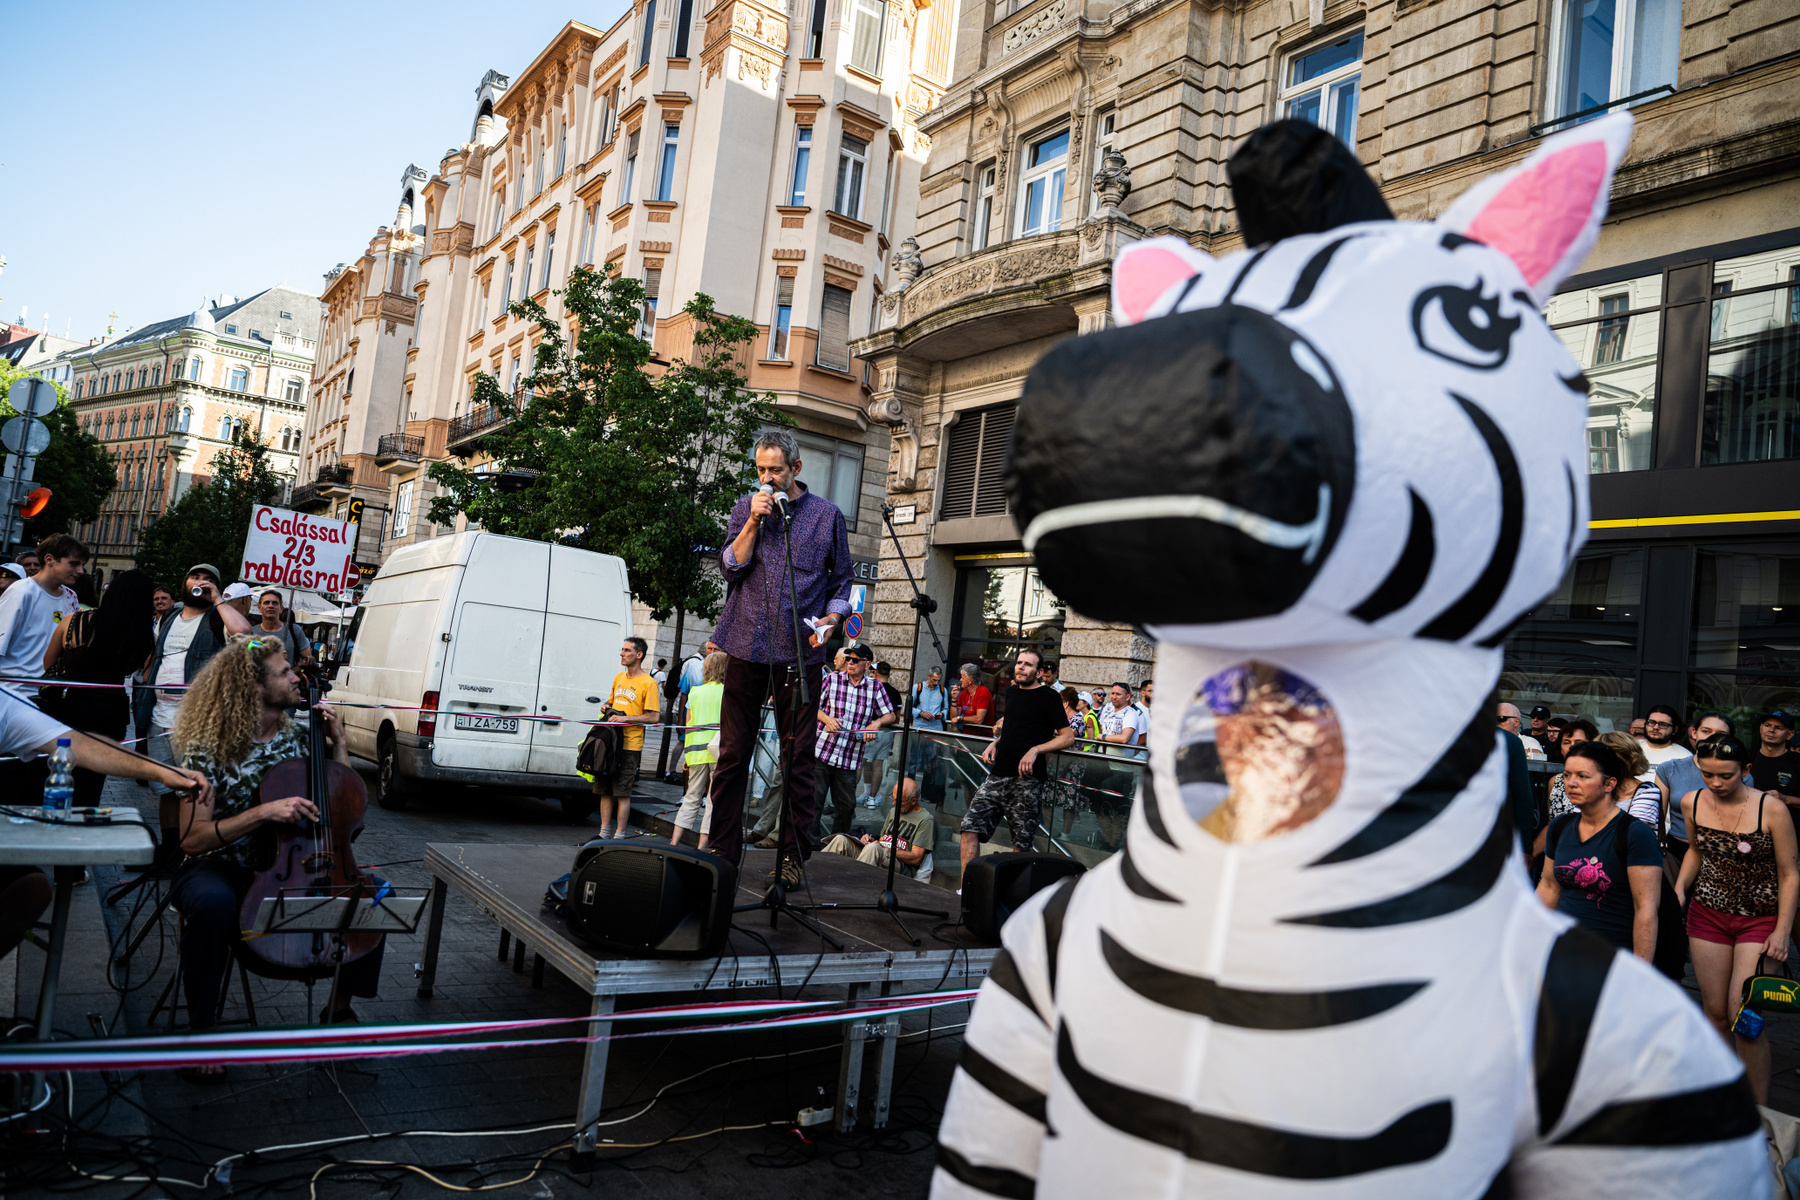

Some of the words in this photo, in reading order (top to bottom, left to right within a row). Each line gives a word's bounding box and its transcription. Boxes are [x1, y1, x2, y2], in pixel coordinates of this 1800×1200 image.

[256, 507, 348, 544] Csalással
[283, 537, 315, 566] 2/3
[244, 554, 351, 594] rablásra!
[1763, 990, 1792, 1003] PUMA
